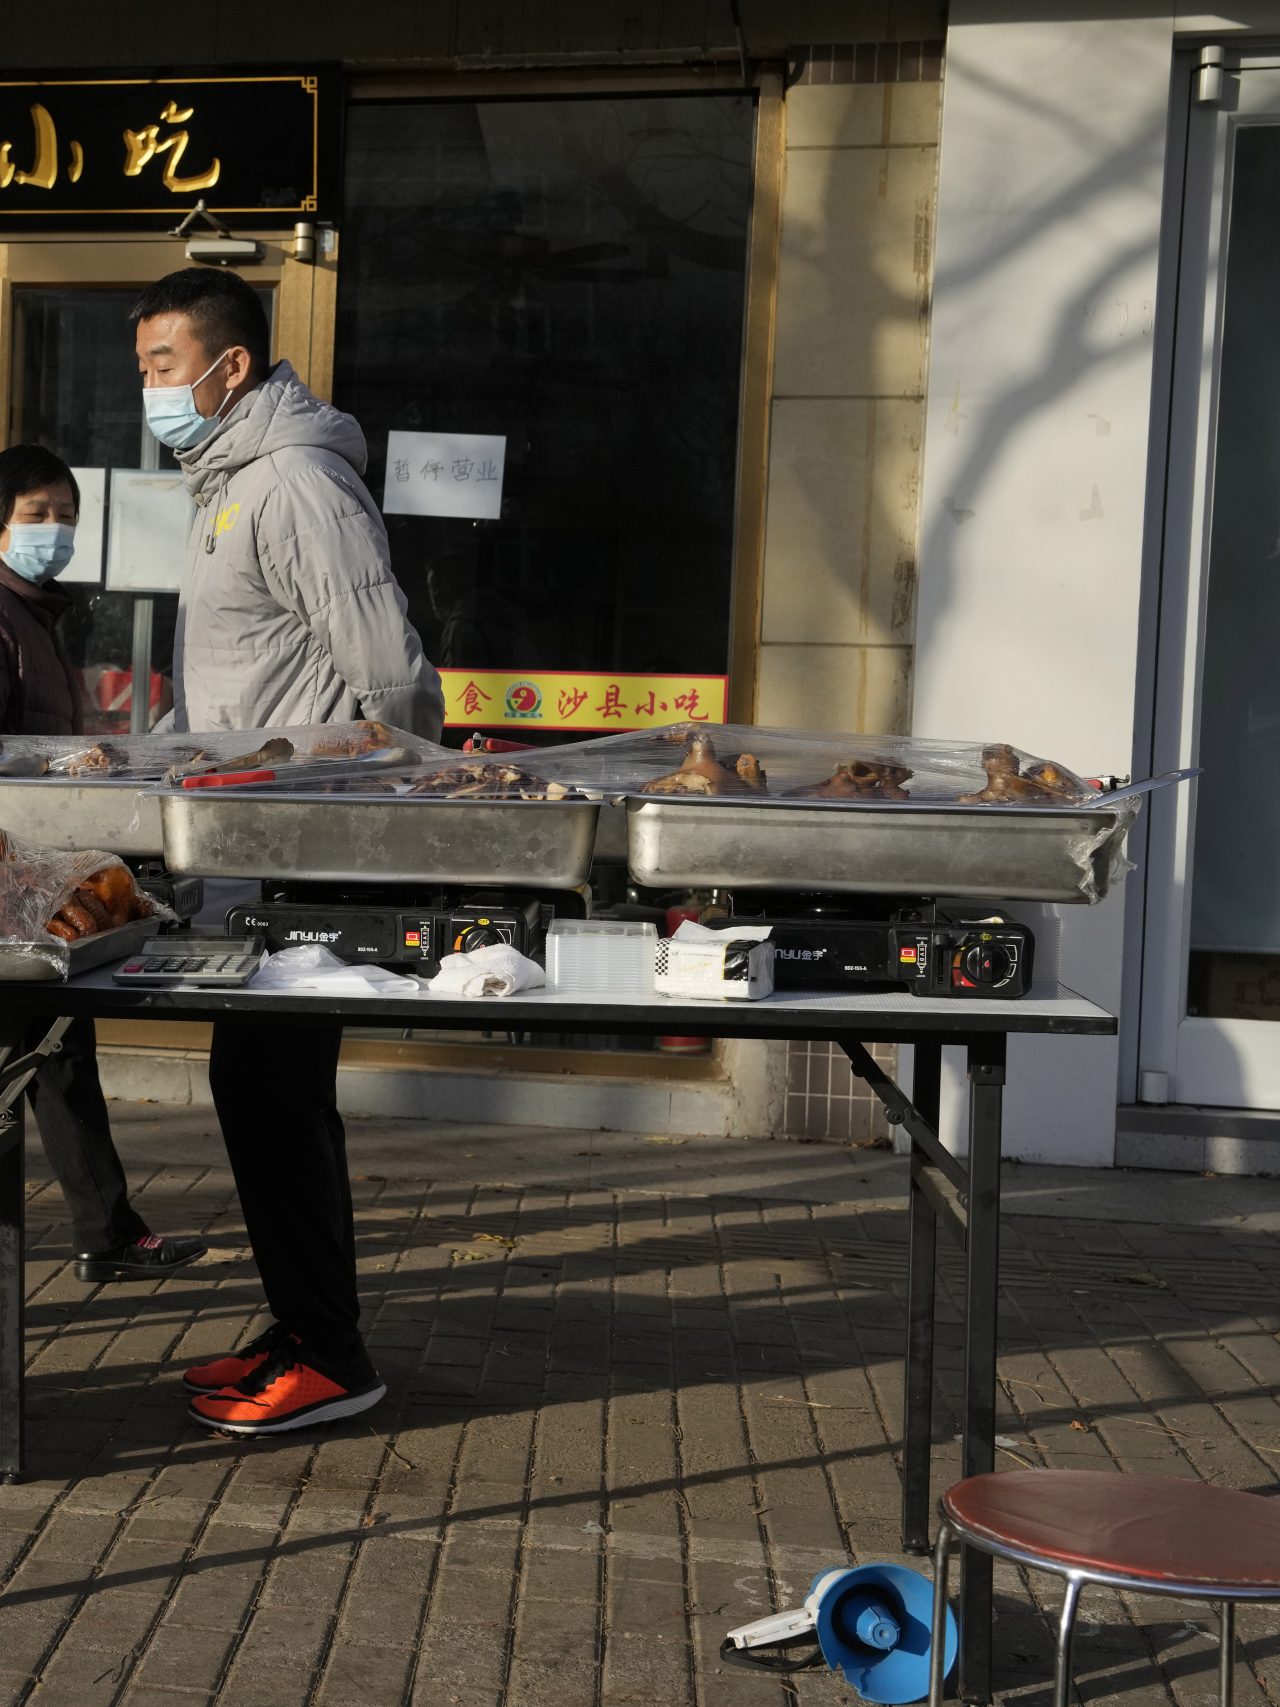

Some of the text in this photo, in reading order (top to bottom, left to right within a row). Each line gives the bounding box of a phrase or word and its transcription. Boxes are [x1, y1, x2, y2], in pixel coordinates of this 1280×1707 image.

[393, 457, 498, 482] 暂停营业
[445, 681, 709, 721] 食 沙县小吃
